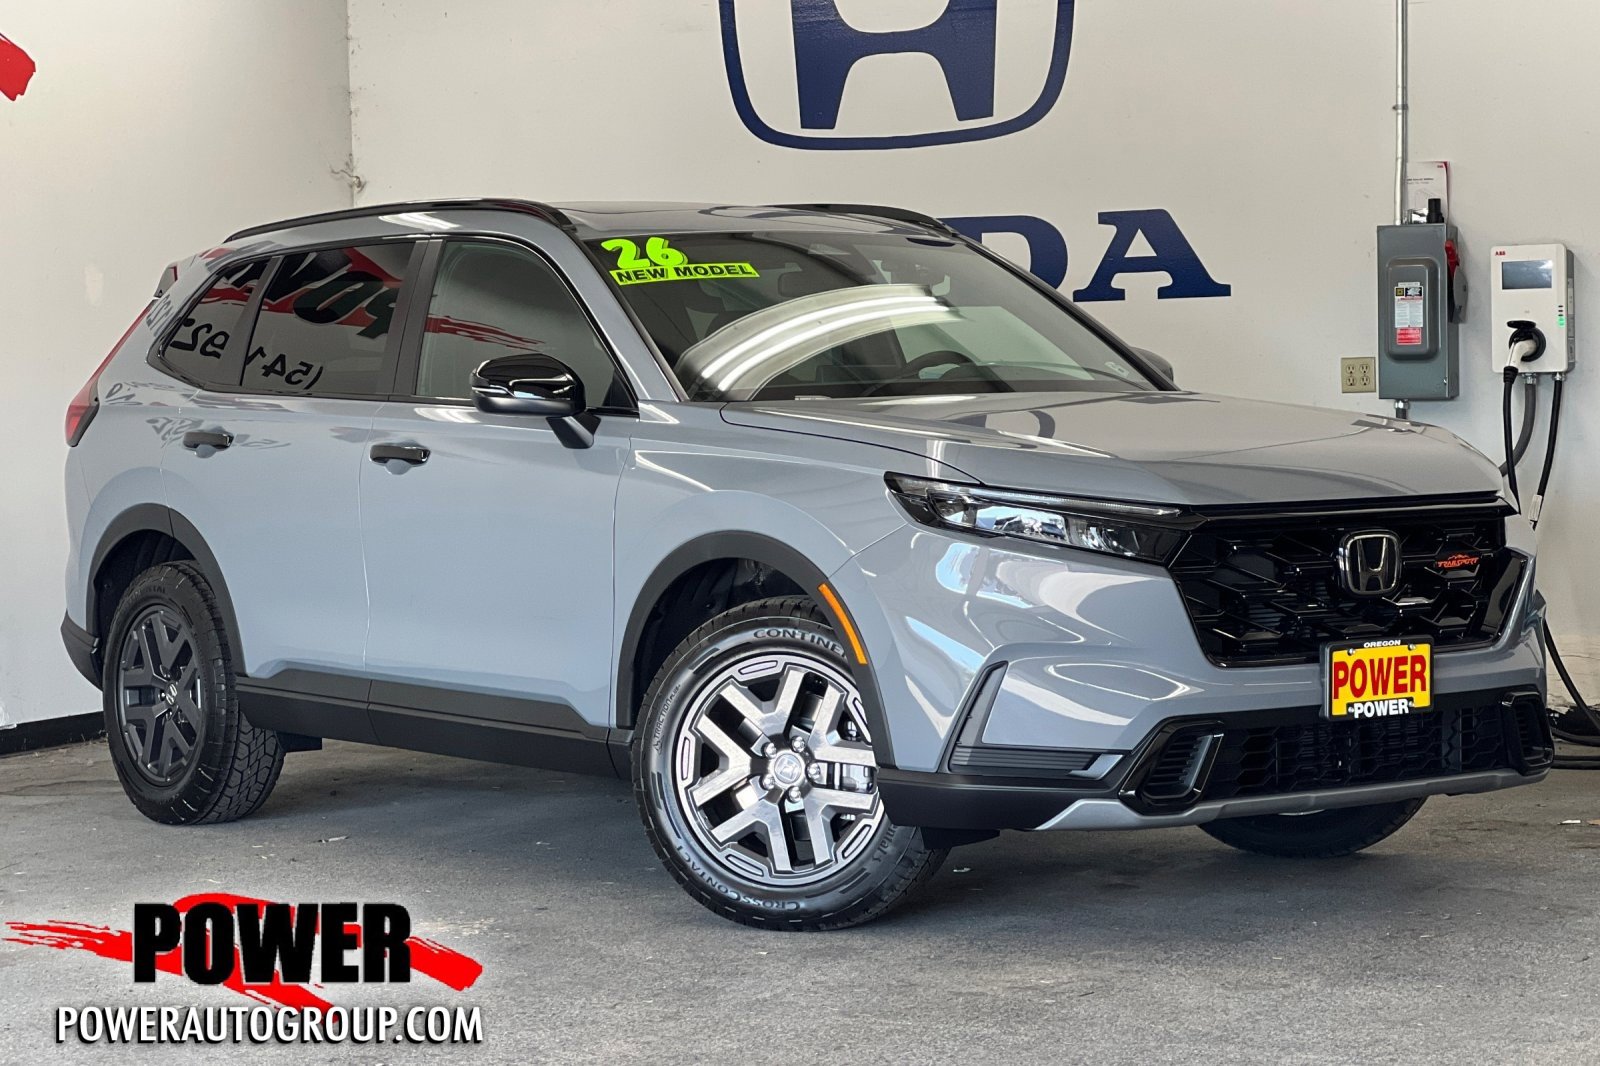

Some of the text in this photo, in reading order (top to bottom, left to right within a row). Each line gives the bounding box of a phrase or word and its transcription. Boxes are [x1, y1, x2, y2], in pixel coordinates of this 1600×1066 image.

[601, 237, 688, 269] 26
[615, 264, 753, 283] NEW MODEL
[1363, 640, 1401, 649] OREGON
[1333, 655, 1427, 700] POWER
[1353, 698, 1409, 719] POWER
